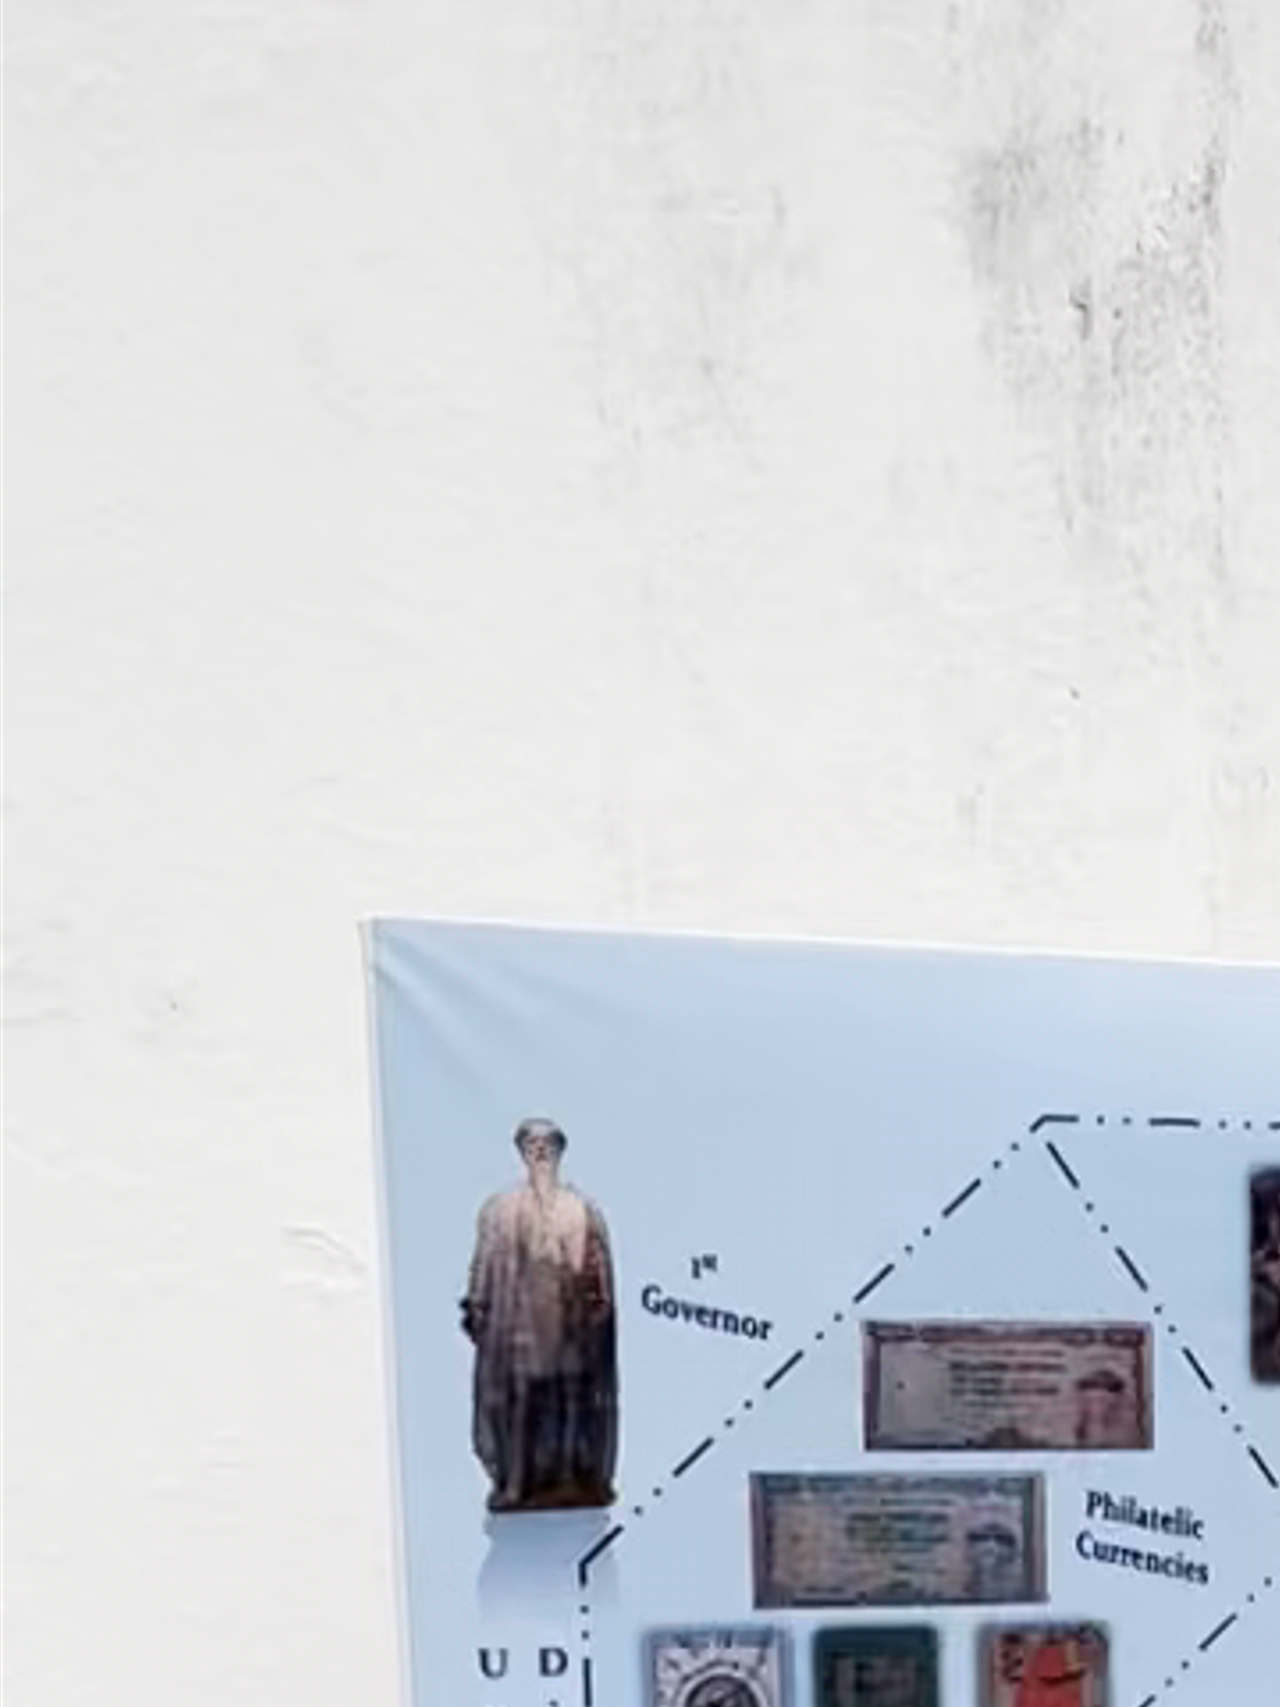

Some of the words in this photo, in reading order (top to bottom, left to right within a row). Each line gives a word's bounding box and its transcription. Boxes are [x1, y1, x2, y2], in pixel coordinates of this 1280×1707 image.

[641, 1284, 773, 1340] Governor
[1085, 1489, 1204, 1540] Philatelic
[1075, 1529, 1209, 1585] Currencies
